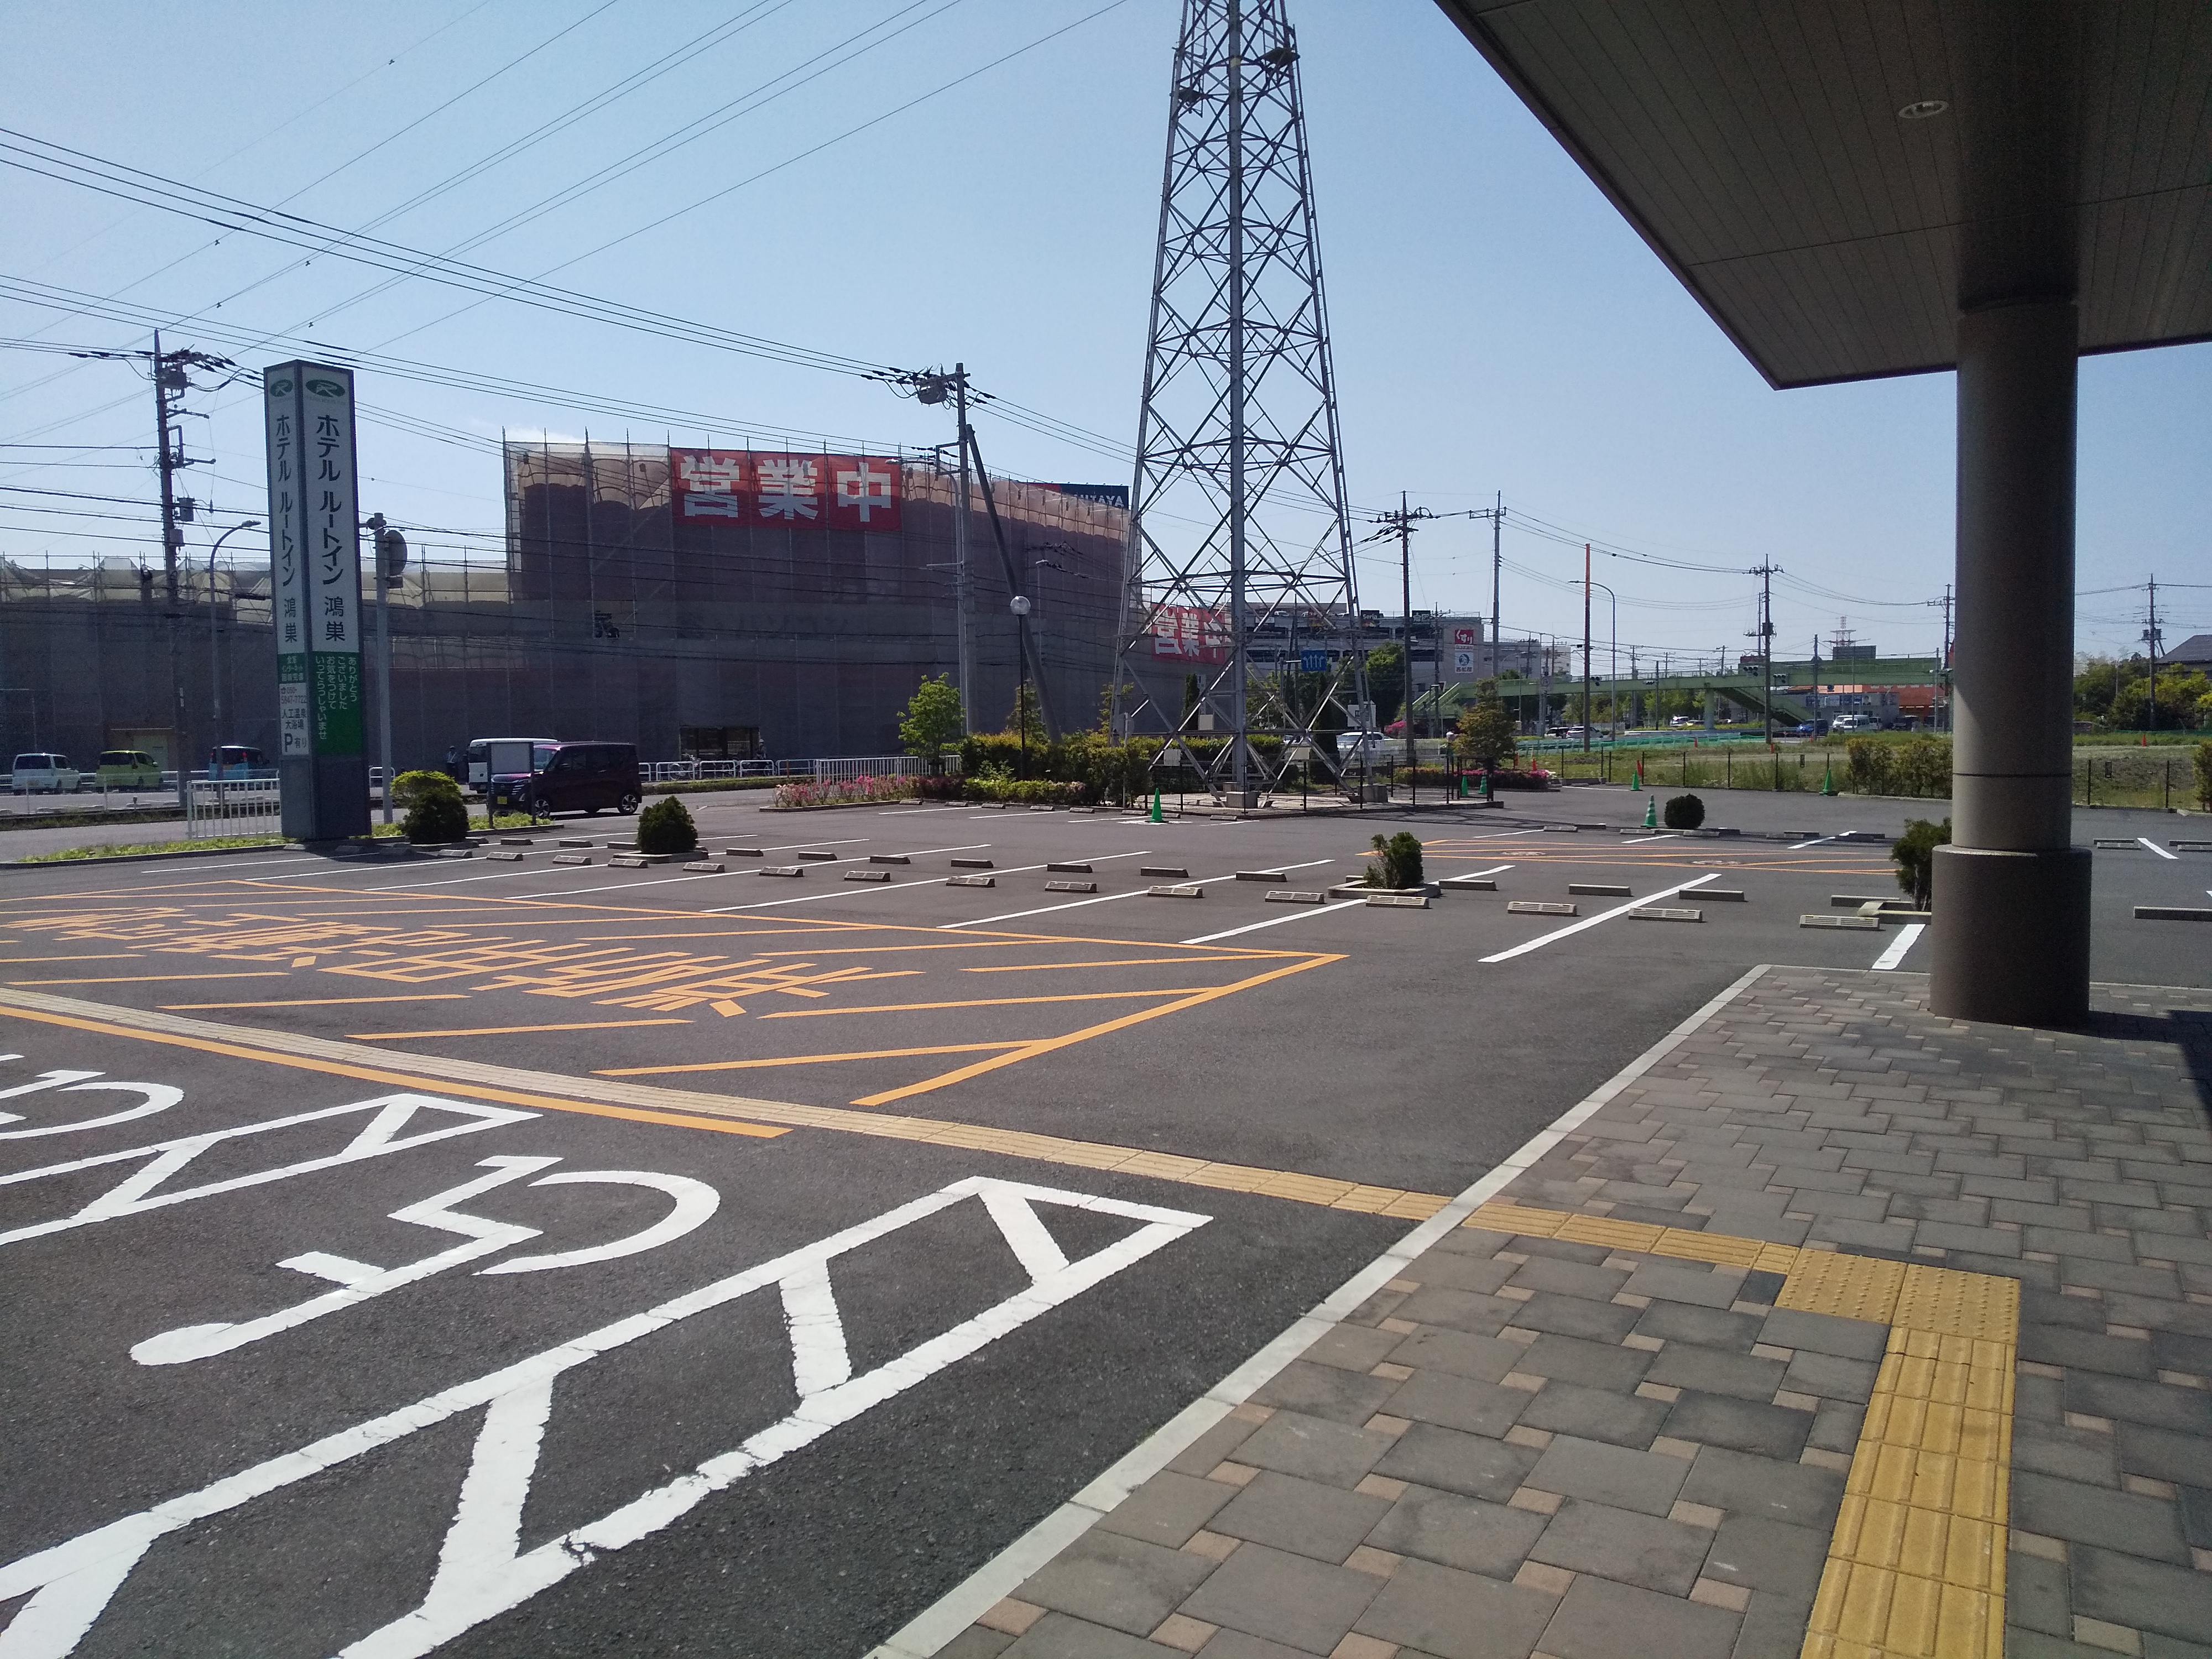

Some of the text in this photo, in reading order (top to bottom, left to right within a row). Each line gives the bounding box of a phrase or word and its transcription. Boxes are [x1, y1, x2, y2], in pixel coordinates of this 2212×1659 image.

[276, 415, 291, 482] ホテル
[316, 415, 341, 482] ホテル
[680, 455, 891, 522] 営業中
[279, 492, 295, 587] ルートイン
[319, 491, 344, 585] ルートイン
[284, 598, 298, 643] 鴻巣
[324, 596, 346, 642] 鴻巣
[316, 656, 327, 739] いってらっしゃいませ
[326, 656, 336, 709] お気をつけて
[338, 656, 347, 709] ございました
[348, 656, 357, 702] ありがとう
[282, 708, 306, 718] 人工温泉
[285, 719, 304, 729] 大浴場
